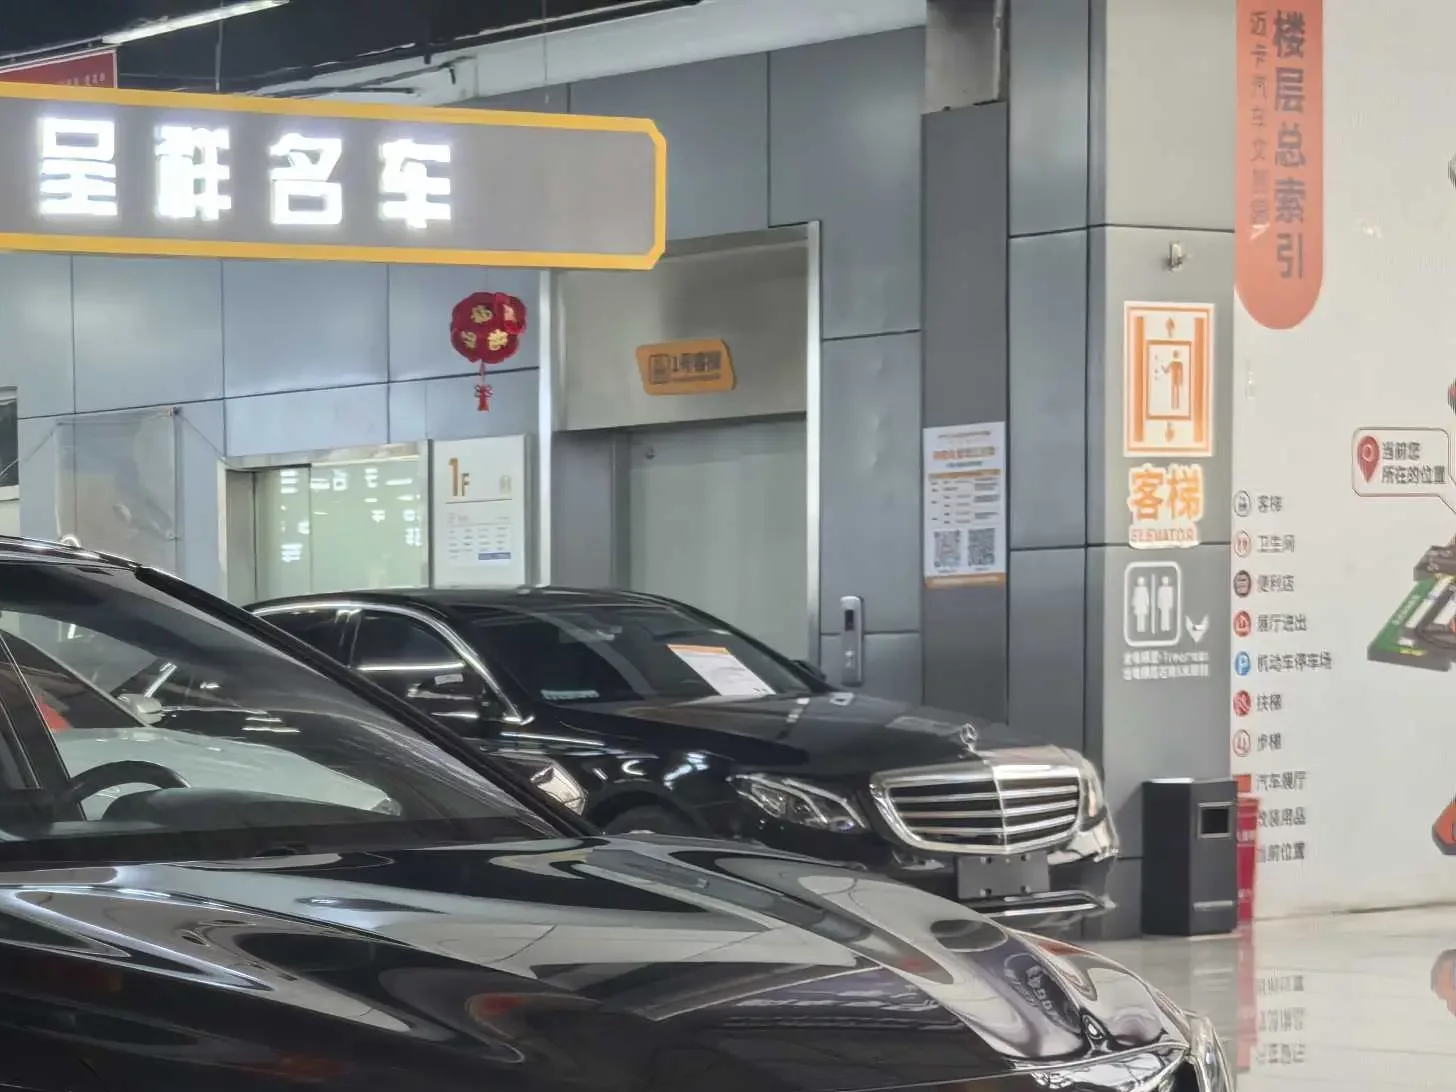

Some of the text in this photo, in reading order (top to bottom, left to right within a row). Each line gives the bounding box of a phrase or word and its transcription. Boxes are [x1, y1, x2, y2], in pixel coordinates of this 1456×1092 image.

[1273, 10, 1306, 279] 楼层总索引
[40, 117, 452, 229] 呈祥名车
[1382, 441, 1420, 460] 当前您
[448, 457, 470, 497] 1F
[1381, 465, 1445, 485] 所在的位置
[1132, 465, 1203, 521] 客梯
[1131, 528, 1194, 542] ELEVATOR
[1257, 534, 1296, 553] 卫生间
[1257, 574, 1296, 593] 便利店
[1257, 613, 1307, 633] 展厅进出
[1257, 651, 1333, 673] 机动车停车场
[1256, 693, 1282, 711] 扶梯
[1257, 733, 1282, 751] 步梯
[1256, 770, 1307, 791] 汽车展厅
